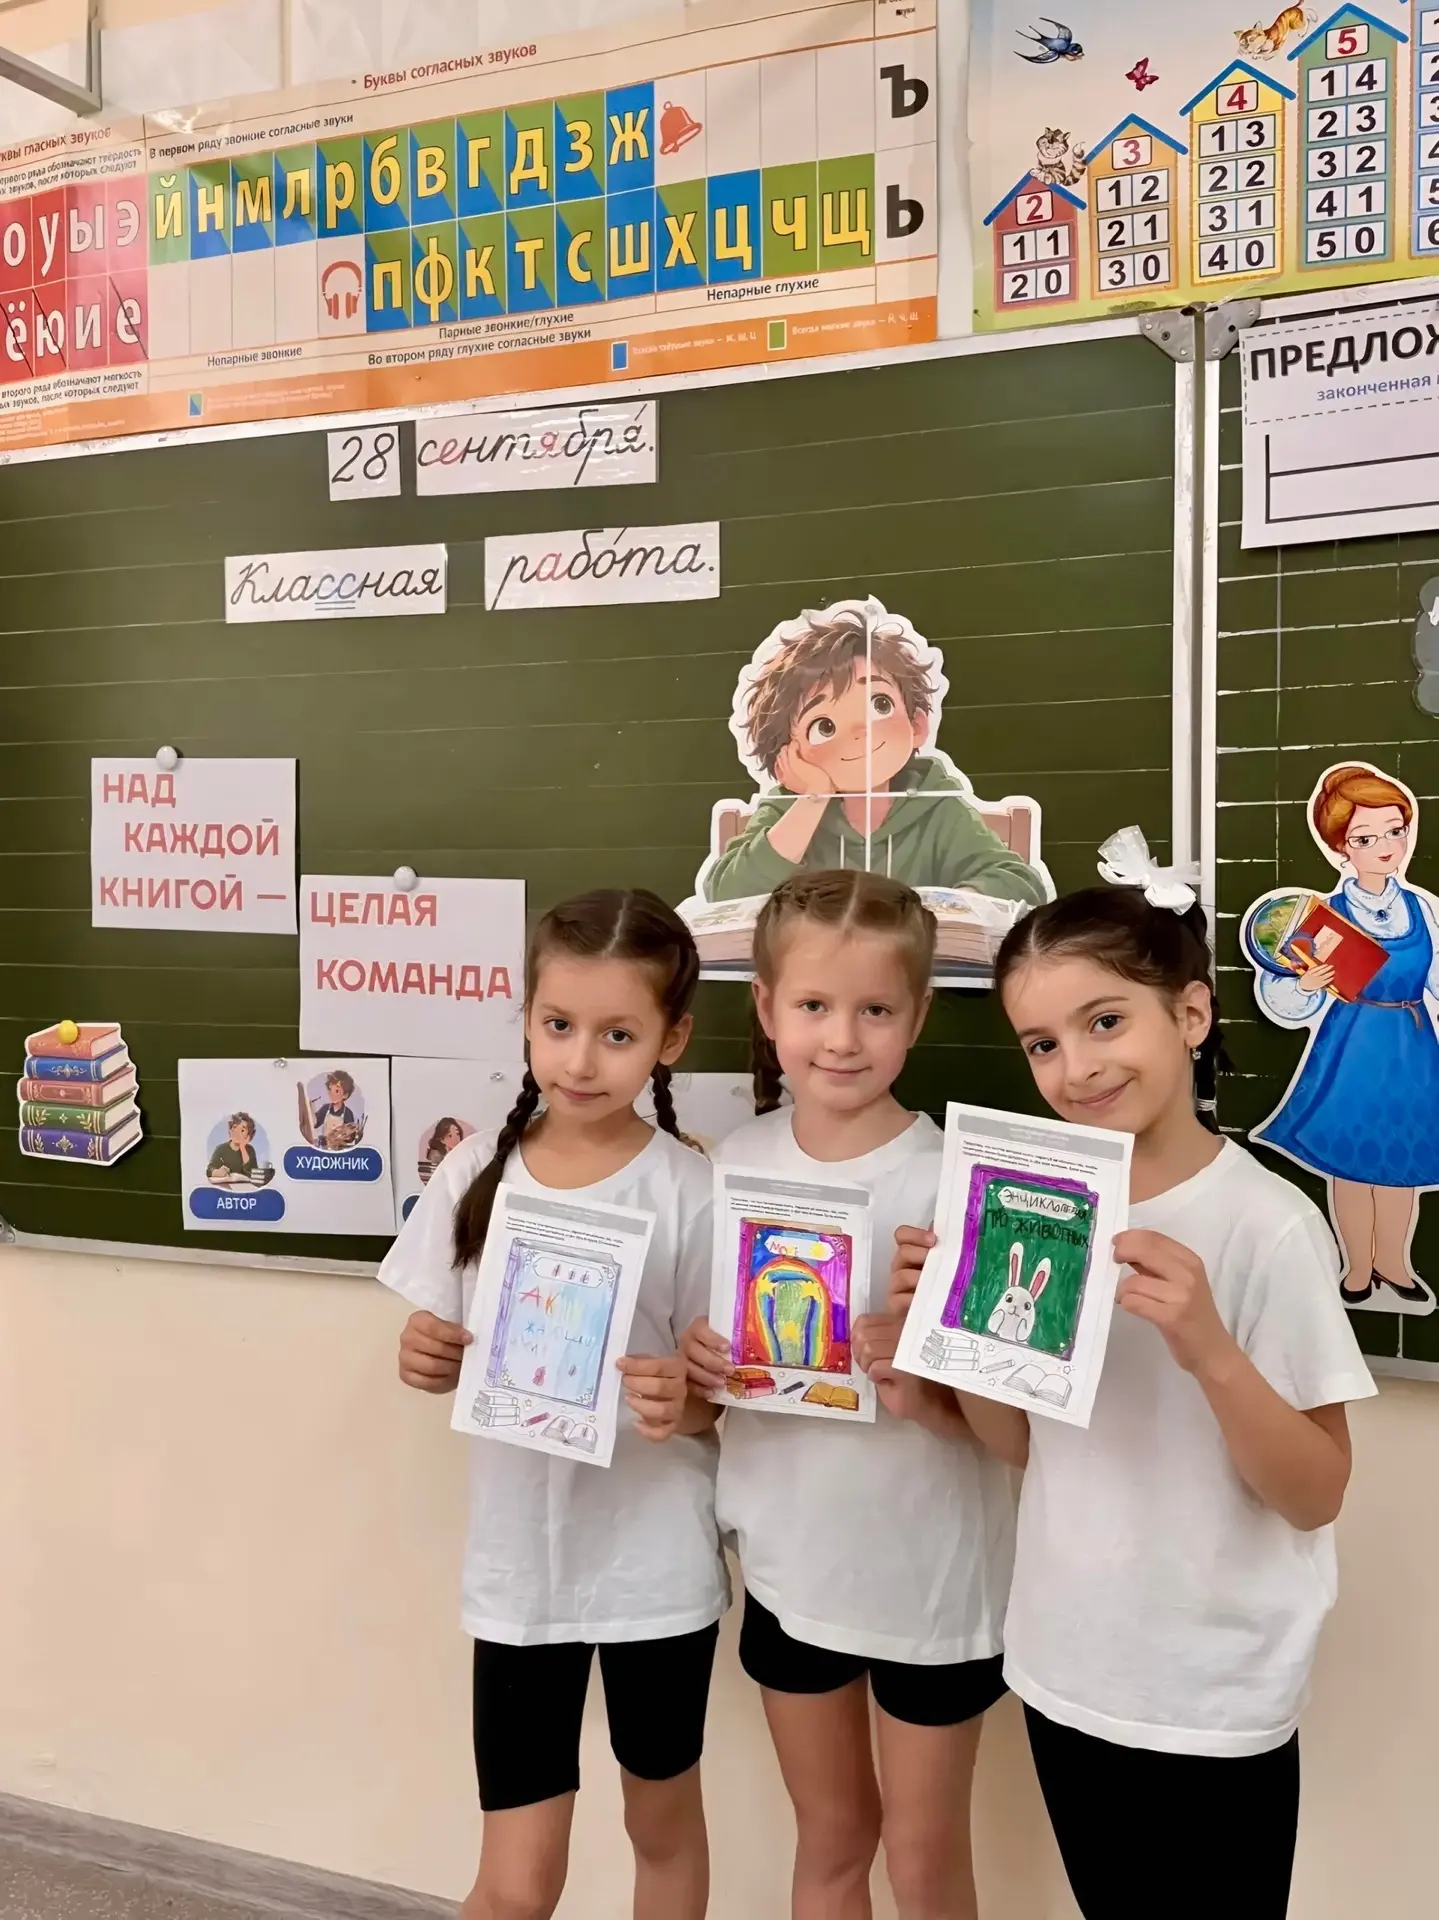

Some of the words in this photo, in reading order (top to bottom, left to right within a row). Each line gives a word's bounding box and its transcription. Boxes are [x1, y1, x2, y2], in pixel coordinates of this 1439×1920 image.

[1337, 29, 1358, 54] 5
[364, 70, 406, 90] Буквы
[411, 54, 483, 79] согласных
[488, 44, 538, 65] звуков
[1322, 71, 1335, 96] 1
[1356, 64, 1377, 90] 4
[1227, 85, 1248, 111] 4
[149, 147, 156, 158] В
[159, 143, 195, 159] первом
[198, 138, 223, 153] ряду
[224, 131, 266, 146] звонкие
[268, 119, 321, 138] согласные
[323, 114, 354, 129] звуки
[1213, 126, 1226, 152] 1
[1246, 120, 1265, 147] 3
[1319, 110, 1337, 137] 2
[1357, 105, 1376, 132] 3
[24, 135, 66, 156] гласных
[70, 127, 112, 146] звуков
[1123, 139, 1141, 165] 3
[48, 157, 97, 174] обозначают
[60, 168, 97, 180] которых
[100, 160, 137, 174] следуют
[155, 175, 183, 240] й
[198, 184, 225, 234] н
[235, 177, 272, 229] м
[282, 168, 310, 219] л
[325, 162, 356, 229] р
[370, 136, 400, 205] б
[416, 146, 448, 199] в
[467, 136, 491, 189] г
[510, 127, 549, 195] д
[564, 120, 594, 173] з
[609, 107, 650, 165] ж
[1210, 165, 1228, 191] 2
[1246, 160, 1265, 187] 2
[1319, 151, 1337, 177] 3
[1356, 146, 1376, 173] 2
[1109, 180, 1122, 206] 1
[1141, 175, 1160, 201] 2
[1316, 191, 1338, 217] 4
[1360, 187, 1373, 213] 1
[1026, 196, 1044, 221] 2
[1209, 205, 1227, 232] 3
[1250, 199, 1262, 225] 1
[3, 228, 26, 268] о
[40, 214, 59, 276] у
[69, 205, 105, 253] ы
[116, 200, 140, 247] э
[1013, 236, 1026, 261] 1
[1046, 230, 1059, 256] 1
[1107, 221, 1126, 247] 2
[1145, 215, 1157, 241] 1
[1317, 231, 1336, 258] 5
[1356, 226, 1375, 253] 0
[372, 260, 403, 312] п
[415, 237, 454, 323] ф
[465, 246, 496, 298] к
[515, 238, 544, 290] т
[566, 230, 593, 284] с
[609, 221, 650, 278] ш
[664, 211, 698, 269] х
[715, 204, 753, 271] ц
[771, 196, 807, 252] ч
[822, 188, 871, 256] щ
[1108, 260, 1127, 286] 3
[1143, 255, 1161, 281] 0
[1208, 245, 1229, 270] 4
[1246, 240, 1264, 267] 0
[707, 284, 772, 301] Непарные
[775, 278, 820, 293] глухие
[1011, 273, 1029, 299] 2
[1045, 268, 1062, 294] 0
[5, 300, 28, 360] ё
[36, 309, 65, 355] ю
[75, 304, 101, 350] и
[116, 298, 142, 346] е
[439, 324, 482, 340] Парные
[484, 312, 574, 333] звонкие/глухие
[207, 351, 259, 367] Непарные
[261, 347, 302, 361] звонкие
[368, 354, 383, 365] Во
[385, 350, 425, 366] втором
[428, 346, 454, 361] ряду
[457, 341, 495, 357] глухие
[497, 332, 556, 351] согласные
[559, 328, 592, 343] звуки
[53, 375, 101, 389] обозначают
[64, 386, 101, 398] которых
[102, 382, 139, 394] следуют
[1317, 375, 1431, 401] законченная
[332, 433, 395, 484] 28
[230, 561, 443, 606] Классная
[103, 773, 176, 808] НАД
[124, 818, 279, 858] КАЖДОЙ
[100, 874, 242, 911] КНИГОЙ
[310, 891, 437, 928] ЦЕЛАЯ
[316, 959, 512, 1001] КОМАНДА
[295, 1154, 369, 1173] ХУДОЖНИК
[216, 1196, 257, 1211] АВТОР
